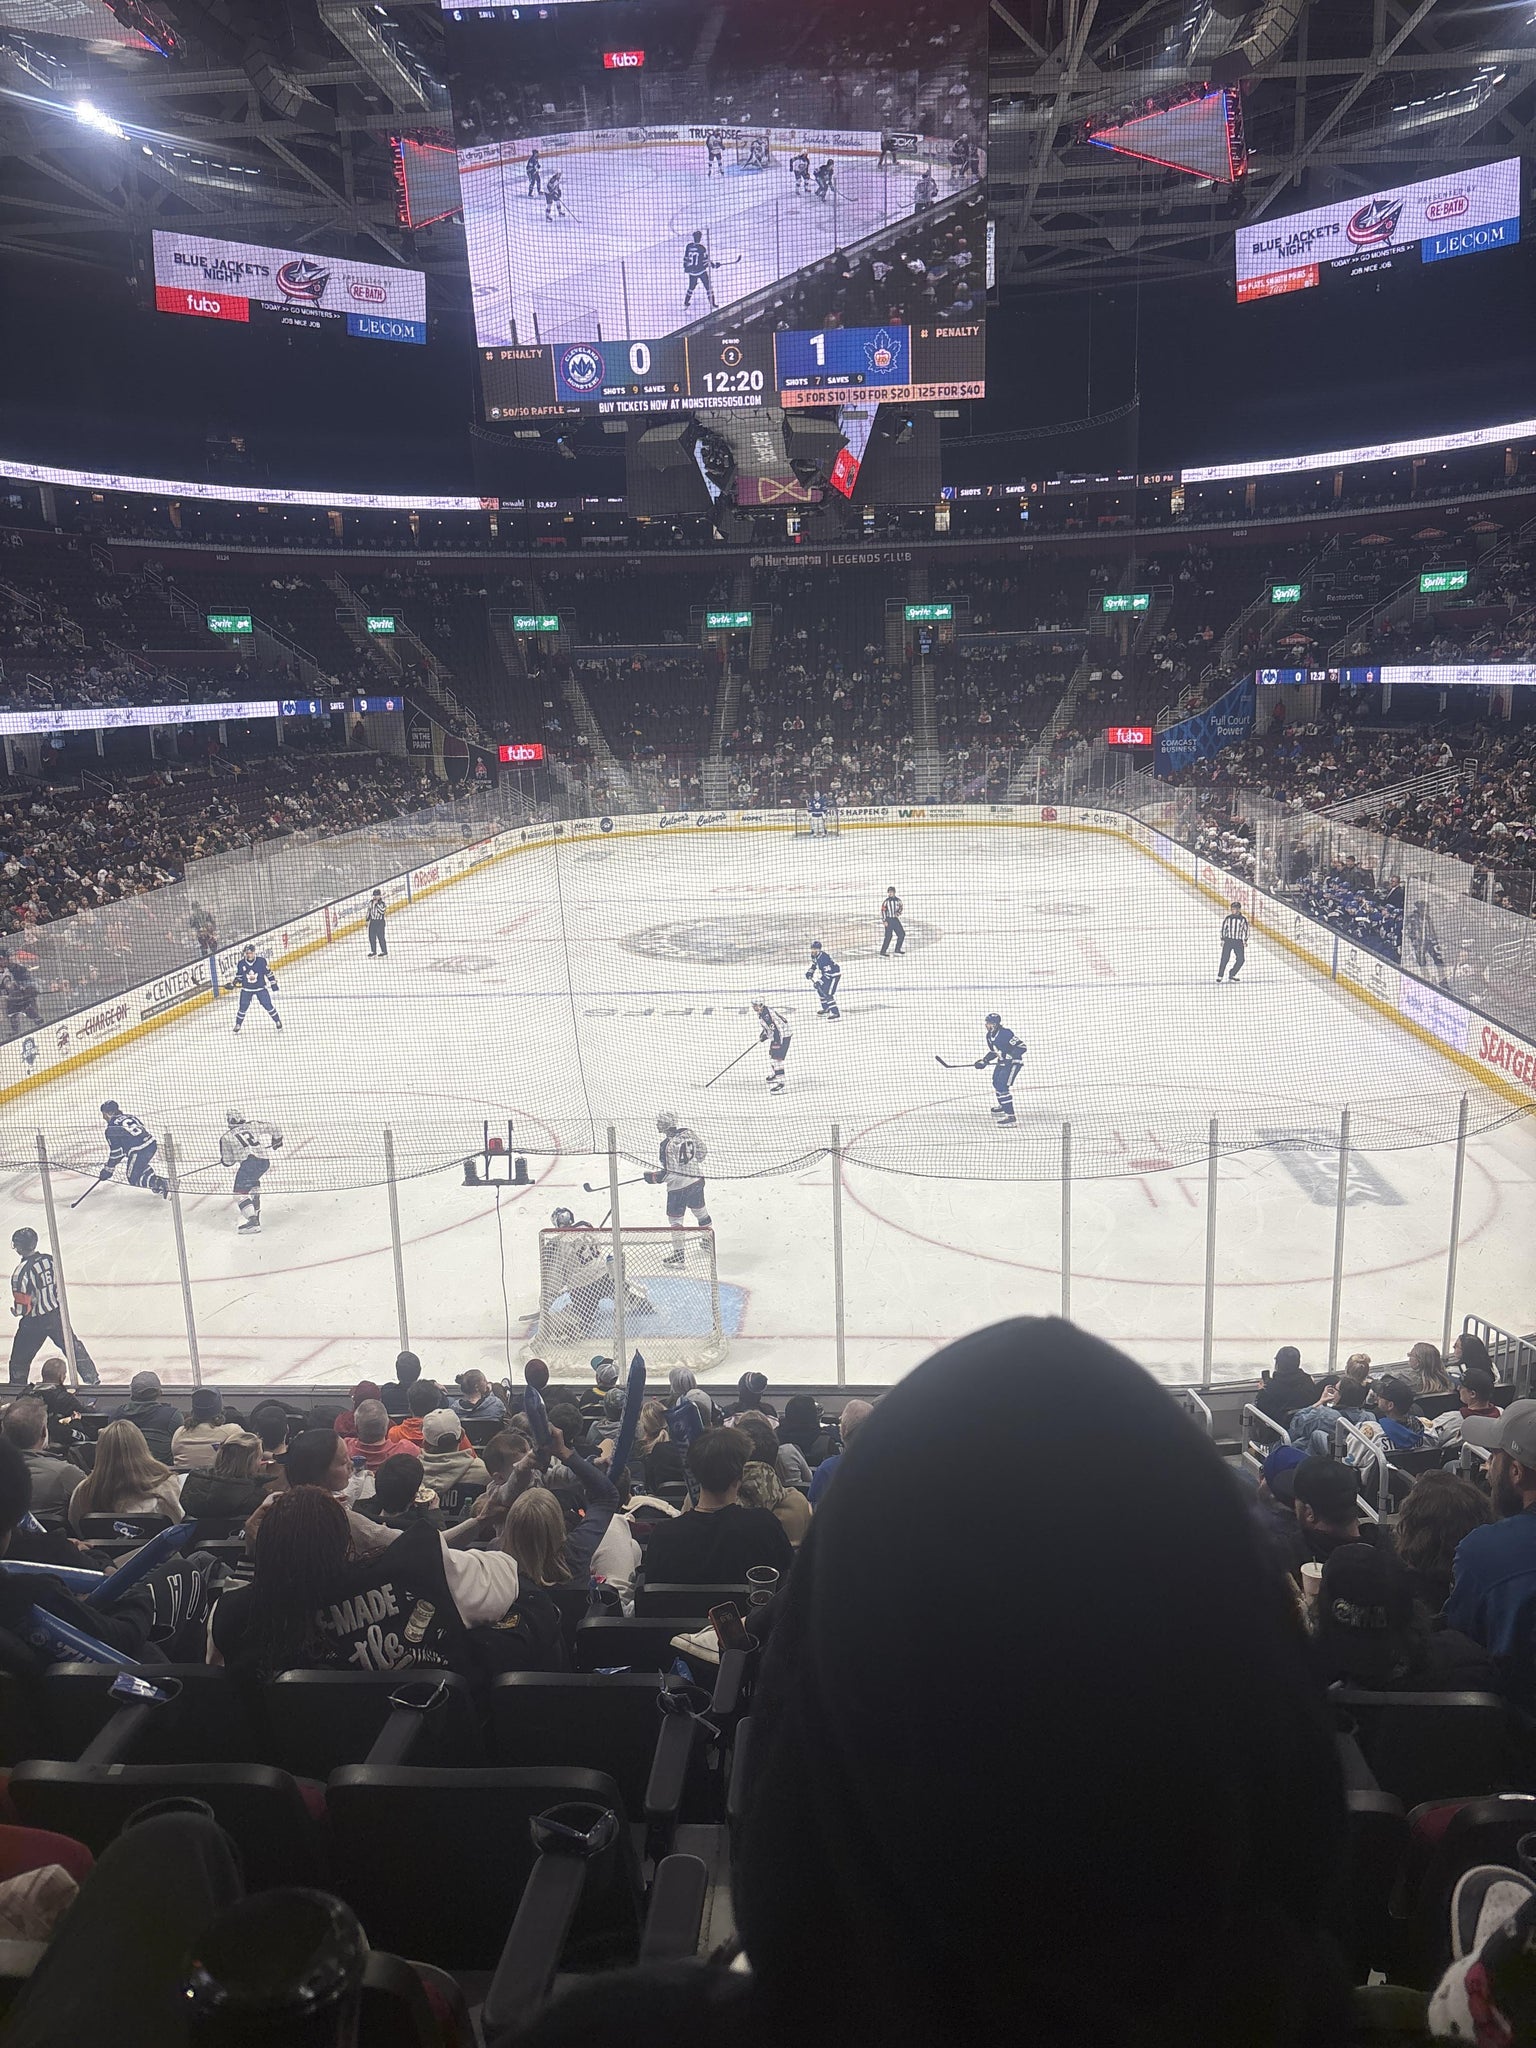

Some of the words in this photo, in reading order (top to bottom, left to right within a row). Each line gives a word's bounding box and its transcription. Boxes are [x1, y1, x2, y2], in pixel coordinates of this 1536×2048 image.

[612, 54, 638, 66] fubo
[1252, 238, 1282, 255] BLUE
[1286, 223, 1340, 246] JACKETS
[1278, 241, 1313, 259] NIGHT
[1370, 245, 1406, 259] MONSTERS
[173, 253, 208, 268] BLUE
[211, 258, 270, 277] JACKETS
[203, 268, 241, 283] NIGHT
[187, 294, 220, 313] fubo
[935, 326, 980, 338] PENALTY
[500, 349, 543, 360] PENALTY
[809, 333, 825, 366] 1
[629, 342, 651, 375] 0
[728, 352, 735, 361] 2
[702, 369, 764, 393] 12:20
[785, 377, 809, 386] SHOTS
[815, 376, 821, 385] 7
[827, 376, 850, 385] SAVES
[856, 374, 863, 383] 9
[602, 387, 626, 396] SHOTS
[632, 386, 639, 395] 9
[643, 385, 666, 394] SAVES
[673, 384, 680, 393] 6
[797, 393, 804, 403] 5
[806, 392, 826, 403] FOR
[827, 391, 846, 402] $10
[852, 390, 866, 401] 50
[868, 389, 888, 400] FOR
[890, 387, 911, 399] $20
[918, 385, 936, 397] 125
[937, 384, 958, 396] FOR
[959, 383, 981, 396] $40
[502, 407, 530, 417] 50/50
[531, 406, 565, 416] RAFFLE
[598, 402, 615, 413] BUY
[616, 400, 649, 412] TICKETS
[650, 399, 668, 411] NOW
[670, 398, 680, 410] AT
[986, 486, 993, 496] 7
[1030, 483, 1038, 493] 9
[1143, 475, 1161, 485] 8:10
[832, 552, 881, 565] LEGENDS
[1422, 576, 1447, 589] Sprite
[1272, 588, 1299, 601] Sprite
[209, 618, 233, 630] Sprite
[368, 618, 394, 631] Sprite
[1295, 672, 1302, 682] 0
[1346, 670, 1351, 681] 1
[309, 701, 316, 713] 6
[360, 700, 368, 711] 9
[1210, 715, 1226, 726] Full
[1227, 714, 1250, 726] Court
[1217, 726, 1244, 737] Power
[1161, 738, 1197, 747] COMCAST
[507, 746, 535, 761] fubo
[1161, 746, 1197, 754] BUSINESS
[1093, 813, 1118, 827] CLIFFS
[152, 970, 189, 1002] CENTER
[40, 1270, 53, 1288] 16
